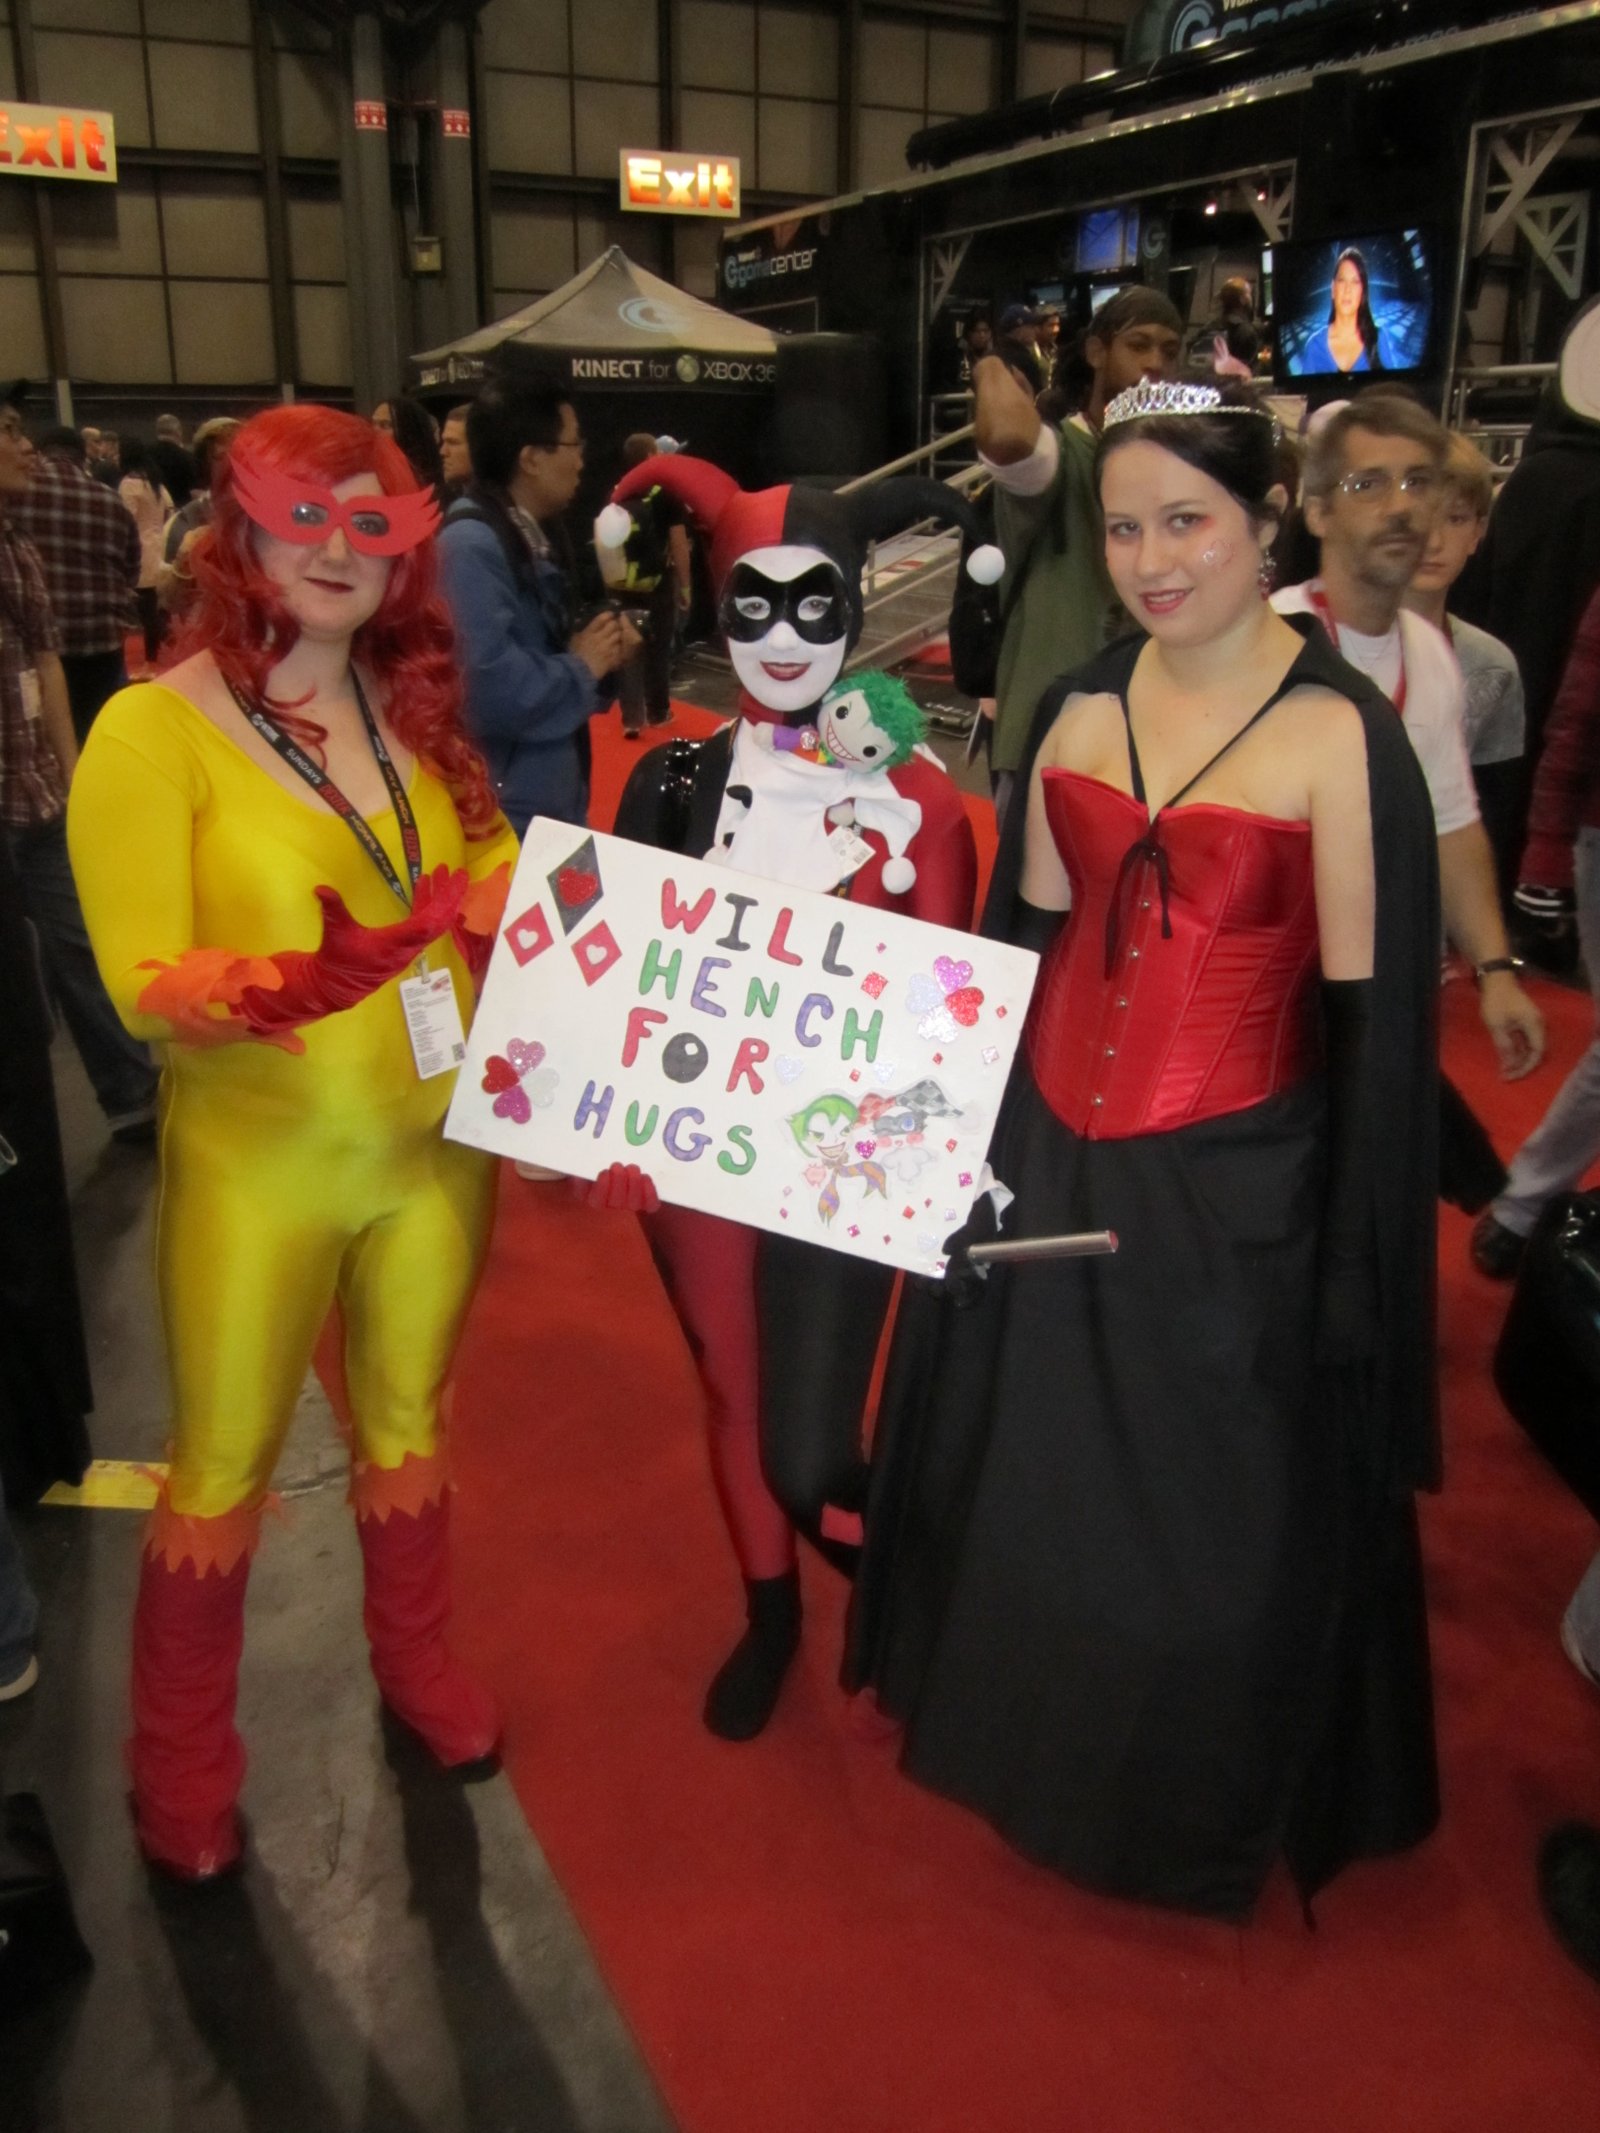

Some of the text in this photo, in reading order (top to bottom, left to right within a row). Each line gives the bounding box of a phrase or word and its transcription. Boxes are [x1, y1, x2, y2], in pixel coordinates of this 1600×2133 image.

[627, 158, 733, 209] Exit
[572, 359, 643, 378] KINECT
[649, 360, 670, 378] for
[704, 361, 752, 381] XBOX
[286, 748, 322, 784] SUNDAYS
[660, 877, 854, 977] WILL
[638, 938, 884, 1064] HENCH
[621, 1006, 770, 1096] FOR
[573, 1079, 757, 1176] HUGS
